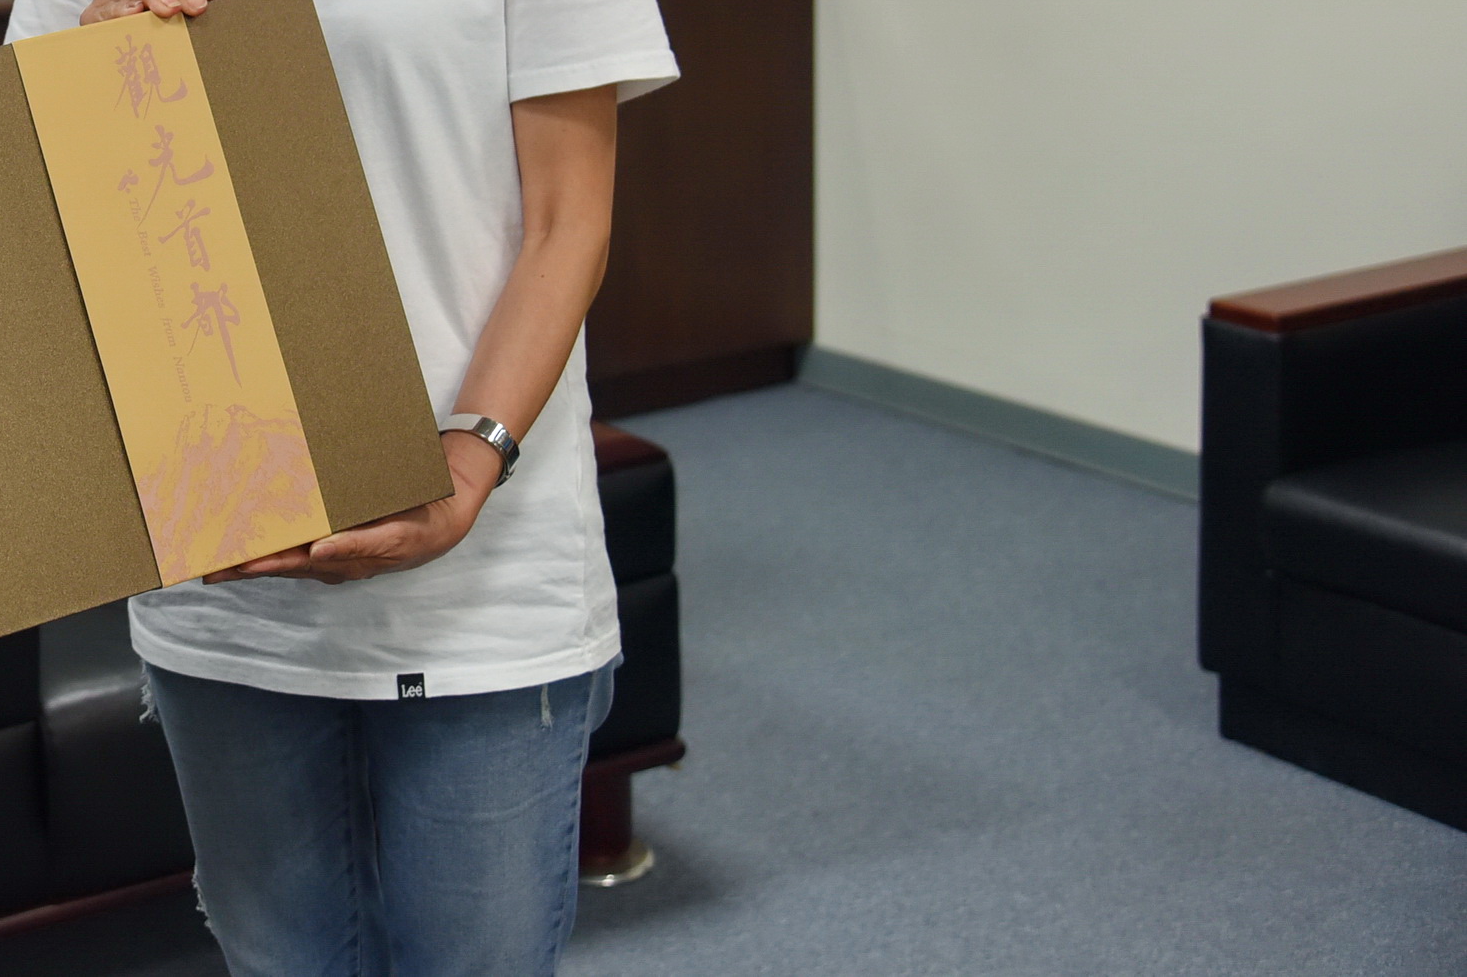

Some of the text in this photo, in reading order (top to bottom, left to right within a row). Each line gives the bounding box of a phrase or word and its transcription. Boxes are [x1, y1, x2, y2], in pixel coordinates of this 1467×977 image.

[114, 34, 242, 389] 觀光首都
[129, 197, 193, 404] The Best Wishes from Nantou
[401, 683, 424, 698] Lee
